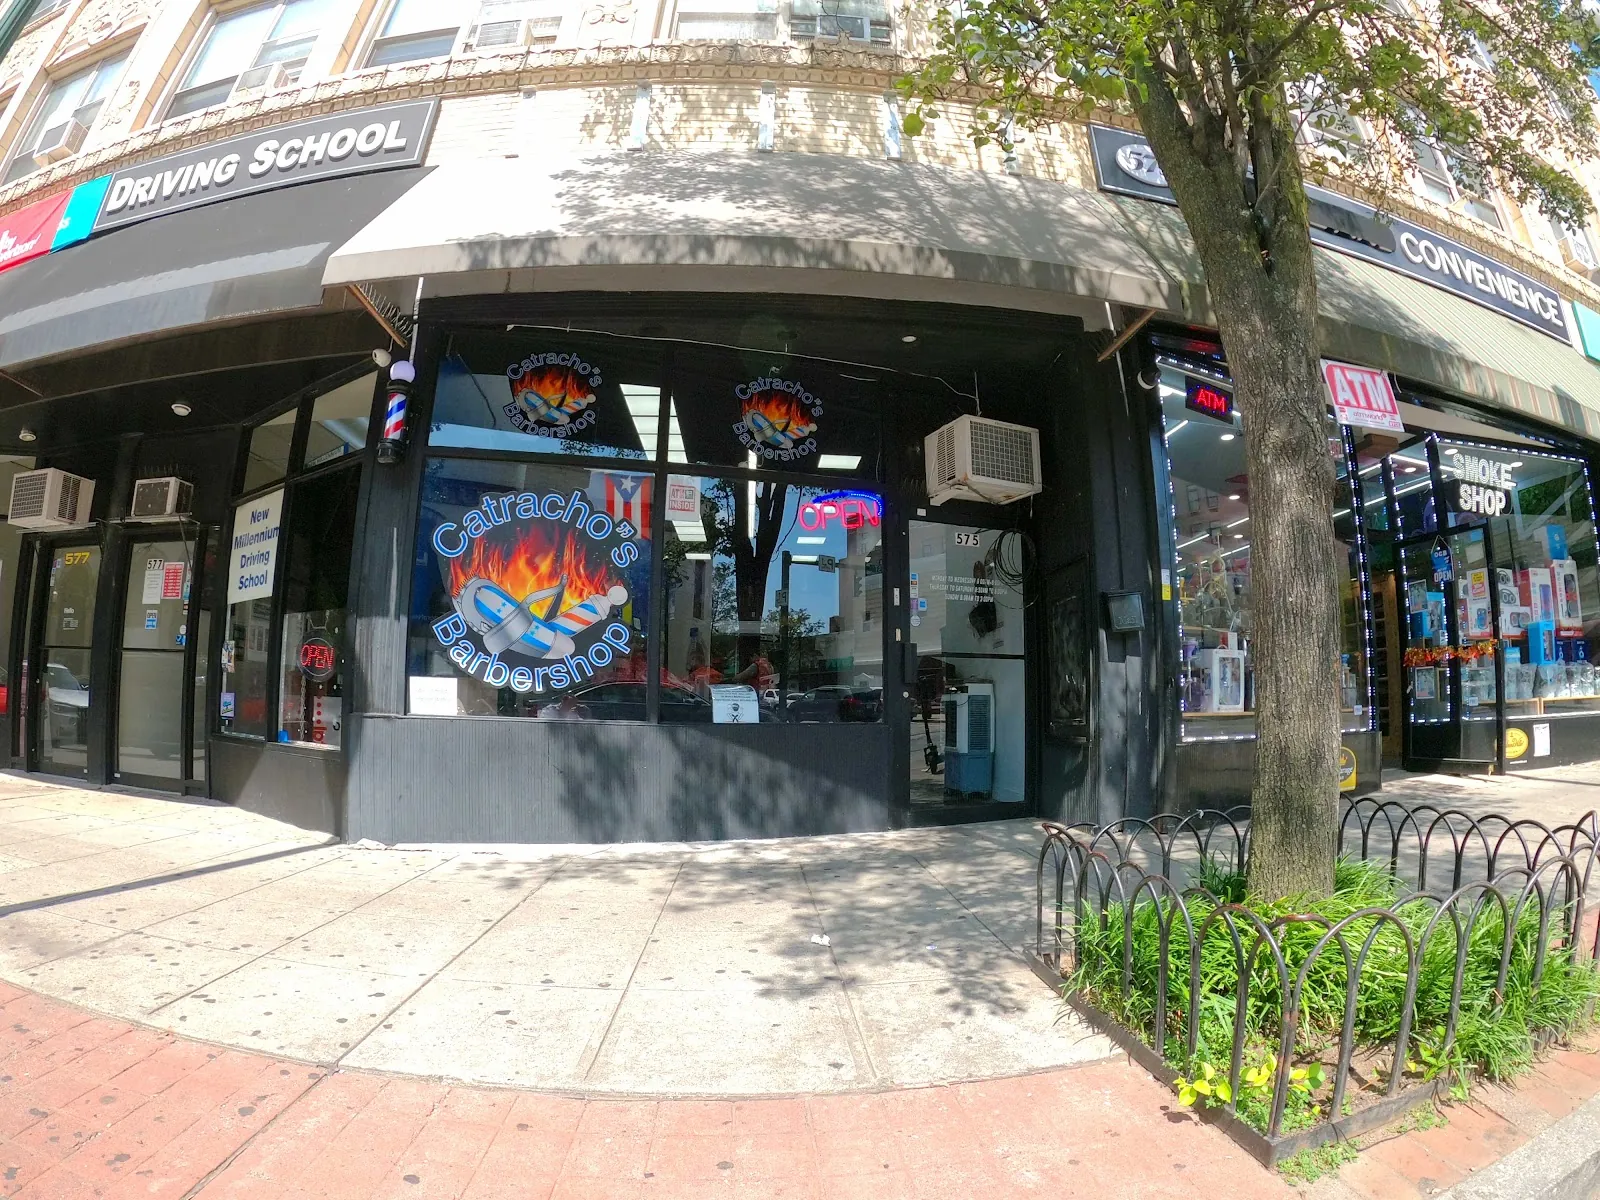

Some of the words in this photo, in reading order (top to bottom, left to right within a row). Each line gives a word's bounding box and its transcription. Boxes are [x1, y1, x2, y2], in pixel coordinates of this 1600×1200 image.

[105, 153, 241, 213] DRIVING
[249, 119, 407, 175] SCHOOL
[1400, 231, 1564, 328] CONVENIENCE
[1197, 388, 1226, 413] ATM
[1332, 367, 1393, 413] ATM
[503, 401, 597, 439] Barbershop
[732, 421, 818, 462] Barbershop
[1451, 453, 1514, 490] SMOKE
[669, 500, 695, 510] INSIDE
[1459, 483, 1507, 517] SHOP
[250, 507, 269, 525] New
[799, 500, 881, 531] OPEN
[234, 525, 280, 550] Millennium
[956, 533, 979, 546] 575
[65, 552, 91, 564] 577
[147, 560, 163, 570] 577
[240, 550, 270, 569] Driving
[238, 572, 268, 590] School
[1434, 570, 1452, 582] OPEN
[301, 645, 335, 670] OPEN
[432, 612, 632, 693] Barbershop
